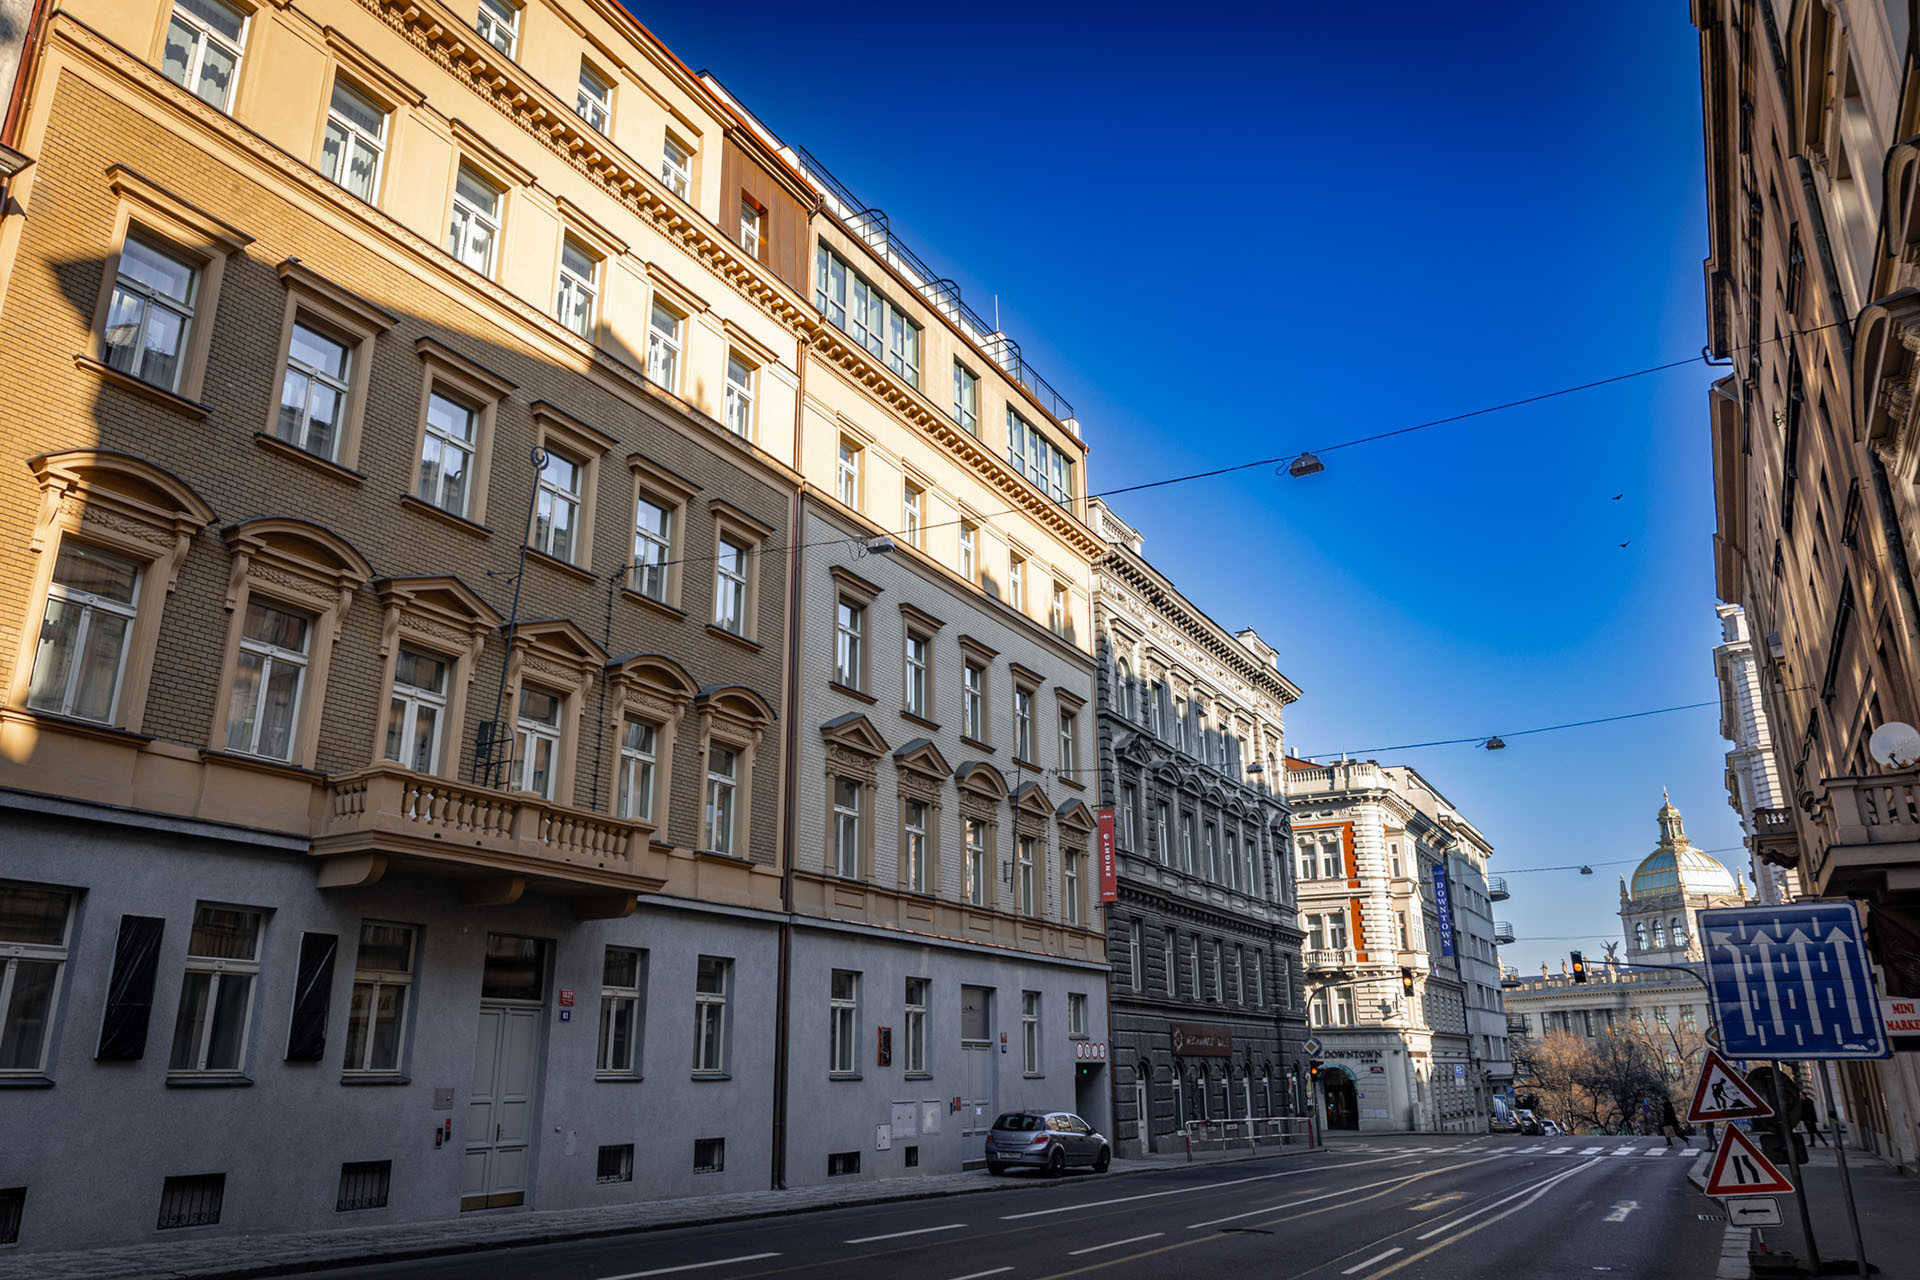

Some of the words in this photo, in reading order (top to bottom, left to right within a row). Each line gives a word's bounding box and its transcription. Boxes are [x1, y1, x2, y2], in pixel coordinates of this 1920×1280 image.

[1436, 882, 1451, 947] DOWNTOWN
[1891, 1003, 1916, 1014] MINI
[1324, 1050, 1383, 1059] DOWNTOWN
